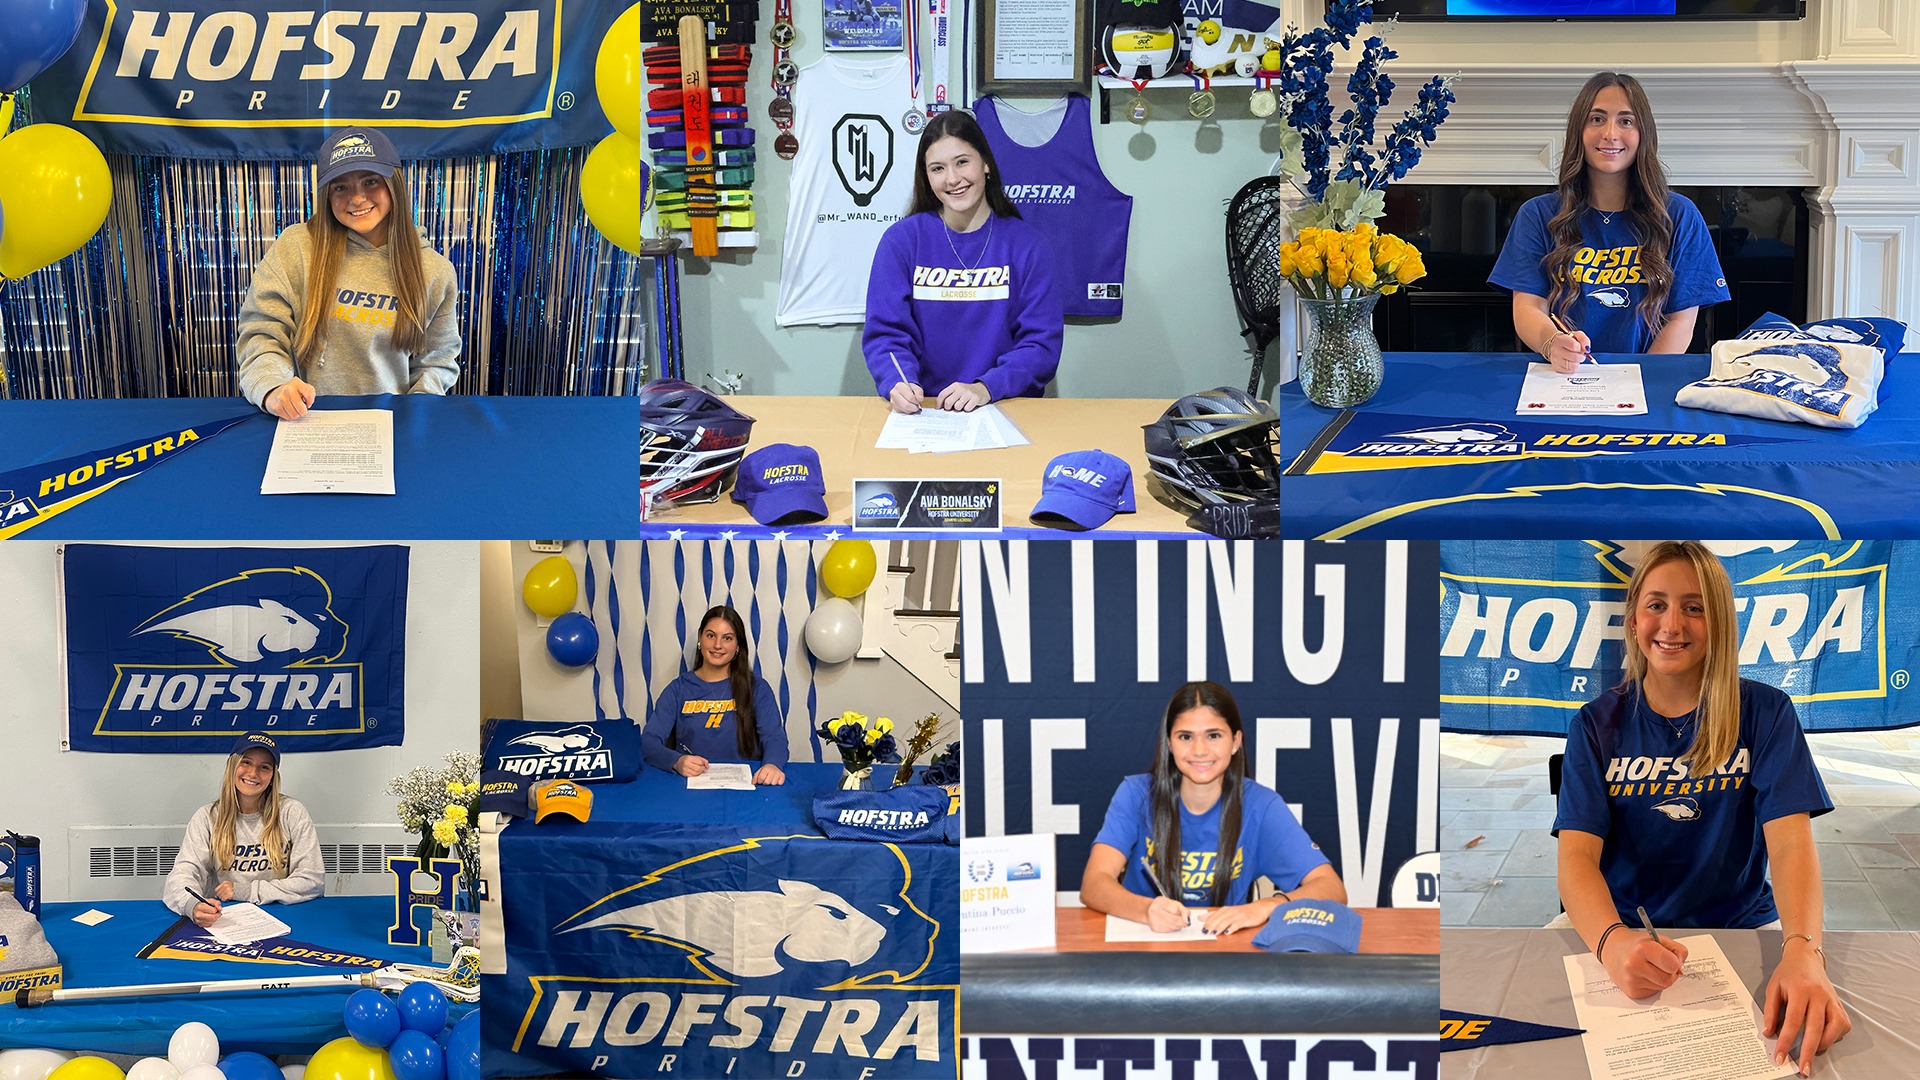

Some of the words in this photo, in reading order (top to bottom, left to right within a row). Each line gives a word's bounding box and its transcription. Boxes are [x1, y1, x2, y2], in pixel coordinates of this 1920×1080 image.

[116, 10, 540, 81] HOFSTRA
[175, 88, 473, 111] PRIDE
[332, 145, 373, 160] HOFSTRA
[914, 265, 1010, 287] HOFSTRA
[335, 288, 400, 311] OFSTR
[941, 290, 978, 299] LACROSSE
[1358, 443, 1518, 453] HOFSTRA
[1534, 433, 1727, 447] HOFSTRA
[38, 428, 200, 498] HOFSTRA
[763, 464, 809, 480] HOFSTRA
[769, 475, 807, 485] LACROSSE
[920, 495, 939, 508] AVA
[942, 495, 993, 508] BONALSKY
[927, 510, 949, 518] HOFSTRA
[949, 510, 980, 518] UNIVERSITY
[1440, 586, 1867, 668] HOFRA
[117, 672, 353, 711] HOFSTRA
[150, 714, 318, 727] PRIDE
[504, 753, 608, 776] HOFSTRA
[481, 781, 518, 792] HOFSTRA
[1609, 776, 1745, 796] UNIVERSITY
[838, 809, 930, 826] HOFSTRA
[408, 893, 445, 906] PRIDE
[992, 905, 1026, 917] Puccio
[1282, 907, 1335, 923] HOFSTRA
[1287, 917, 1328, 927] LACROSSE
[268, 945, 384, 968] HOFSTRA
[537, 990, 940, 1062] HOFSTRA
